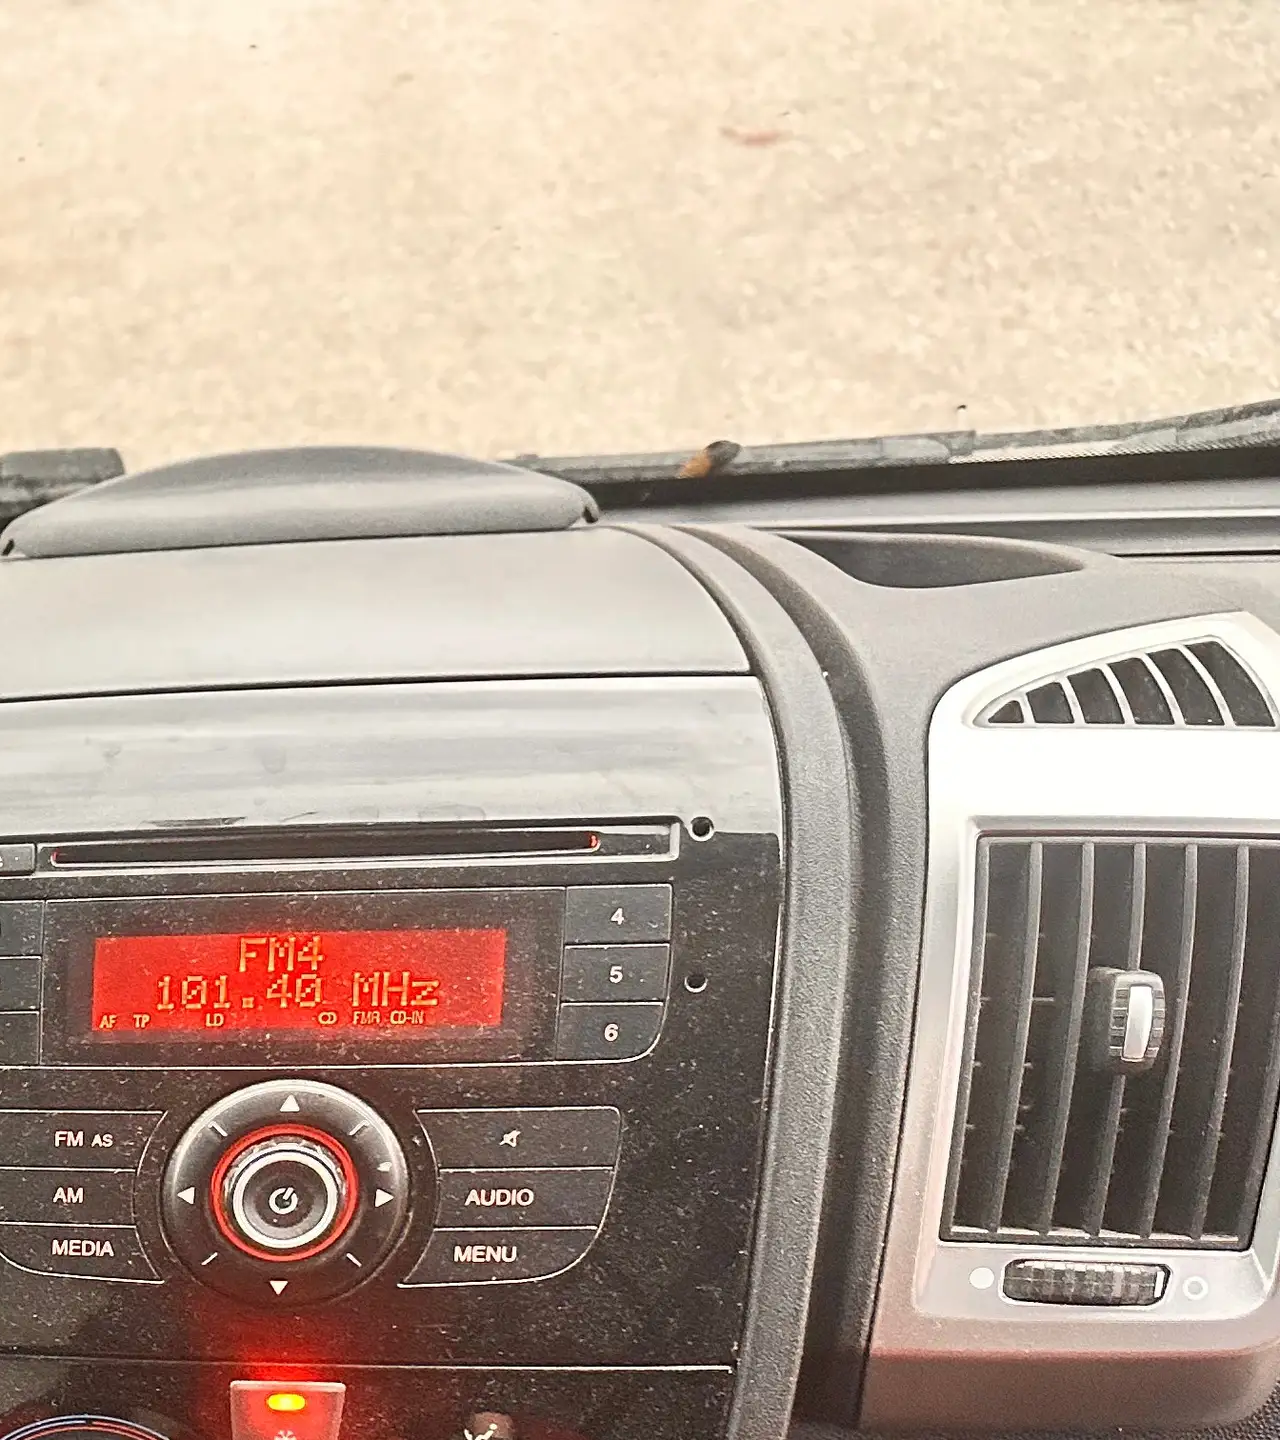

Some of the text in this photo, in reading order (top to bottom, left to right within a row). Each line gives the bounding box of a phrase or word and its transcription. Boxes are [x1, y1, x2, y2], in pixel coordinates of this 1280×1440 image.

[611, 908, 625, 925] 4
[239, 936, 323, 972] FM4
[609, 966, 623, 983] 5
[157, 972, 439, 1010] 101.40 MHz
[99, 1014, 117, 1028] AF
[133, 1014, 151, 1028] TP
[604, 1023, 619, 1041] 6
[54, 1131, 114, 1148] FM AS
[53, 1186, 83, 1203] AM
[464, 1188, 534, 1206] AUDIO
[52, 1240, 115, 1257] MEDIA
[453, 1245, 517, 1263] MENU
